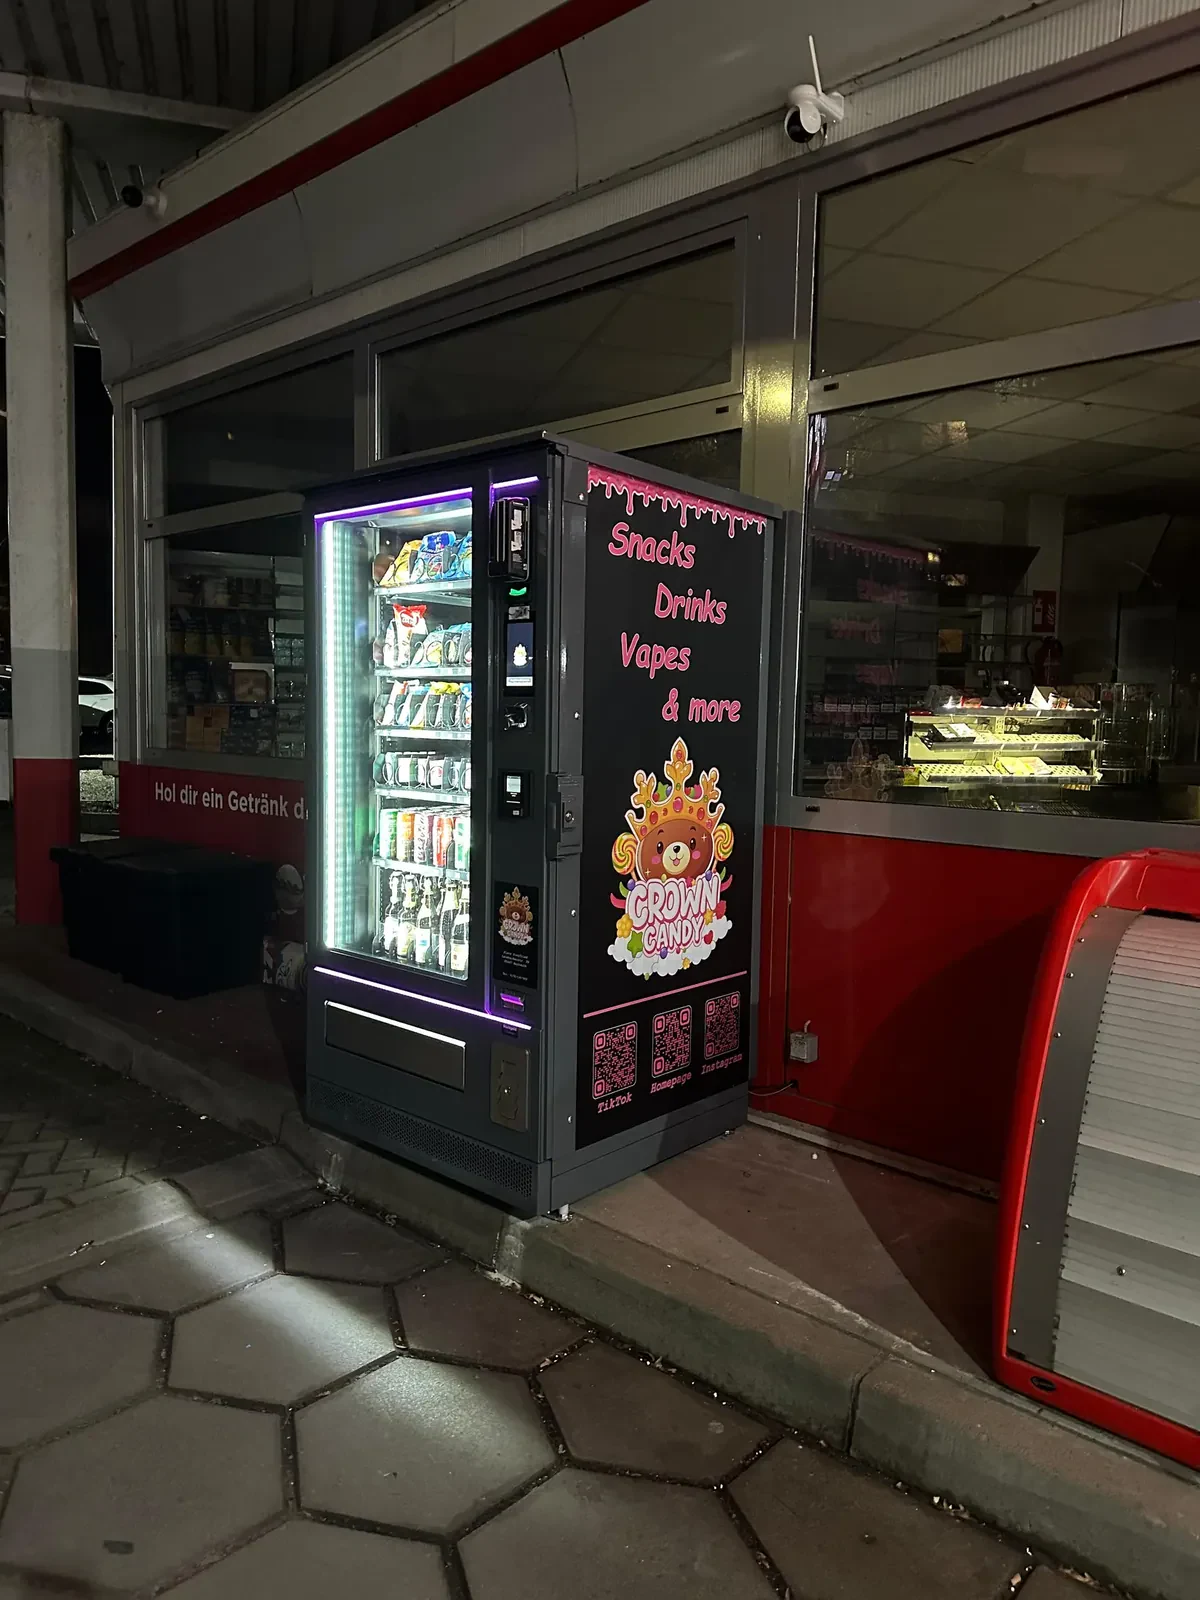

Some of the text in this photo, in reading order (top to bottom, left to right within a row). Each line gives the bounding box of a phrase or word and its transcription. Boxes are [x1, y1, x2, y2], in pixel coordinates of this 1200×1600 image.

[608, 521, 696, 569] Snacks
[654, 582, 727, 625] Drinks
[620, 632, 691, 680] Vapes
[661, 687, 741, 723] & more
[155, 781, 309, 820] Hol dir ein Getränk d
[627, 874, 720, 929] CROWN
[643, 915, 704, 955] CANDY
[650, 1071, 692, 1094] Homepage
[700, 1053, 743, 1075] Instagram
[597, 1092, 633, 1114] TikTok
